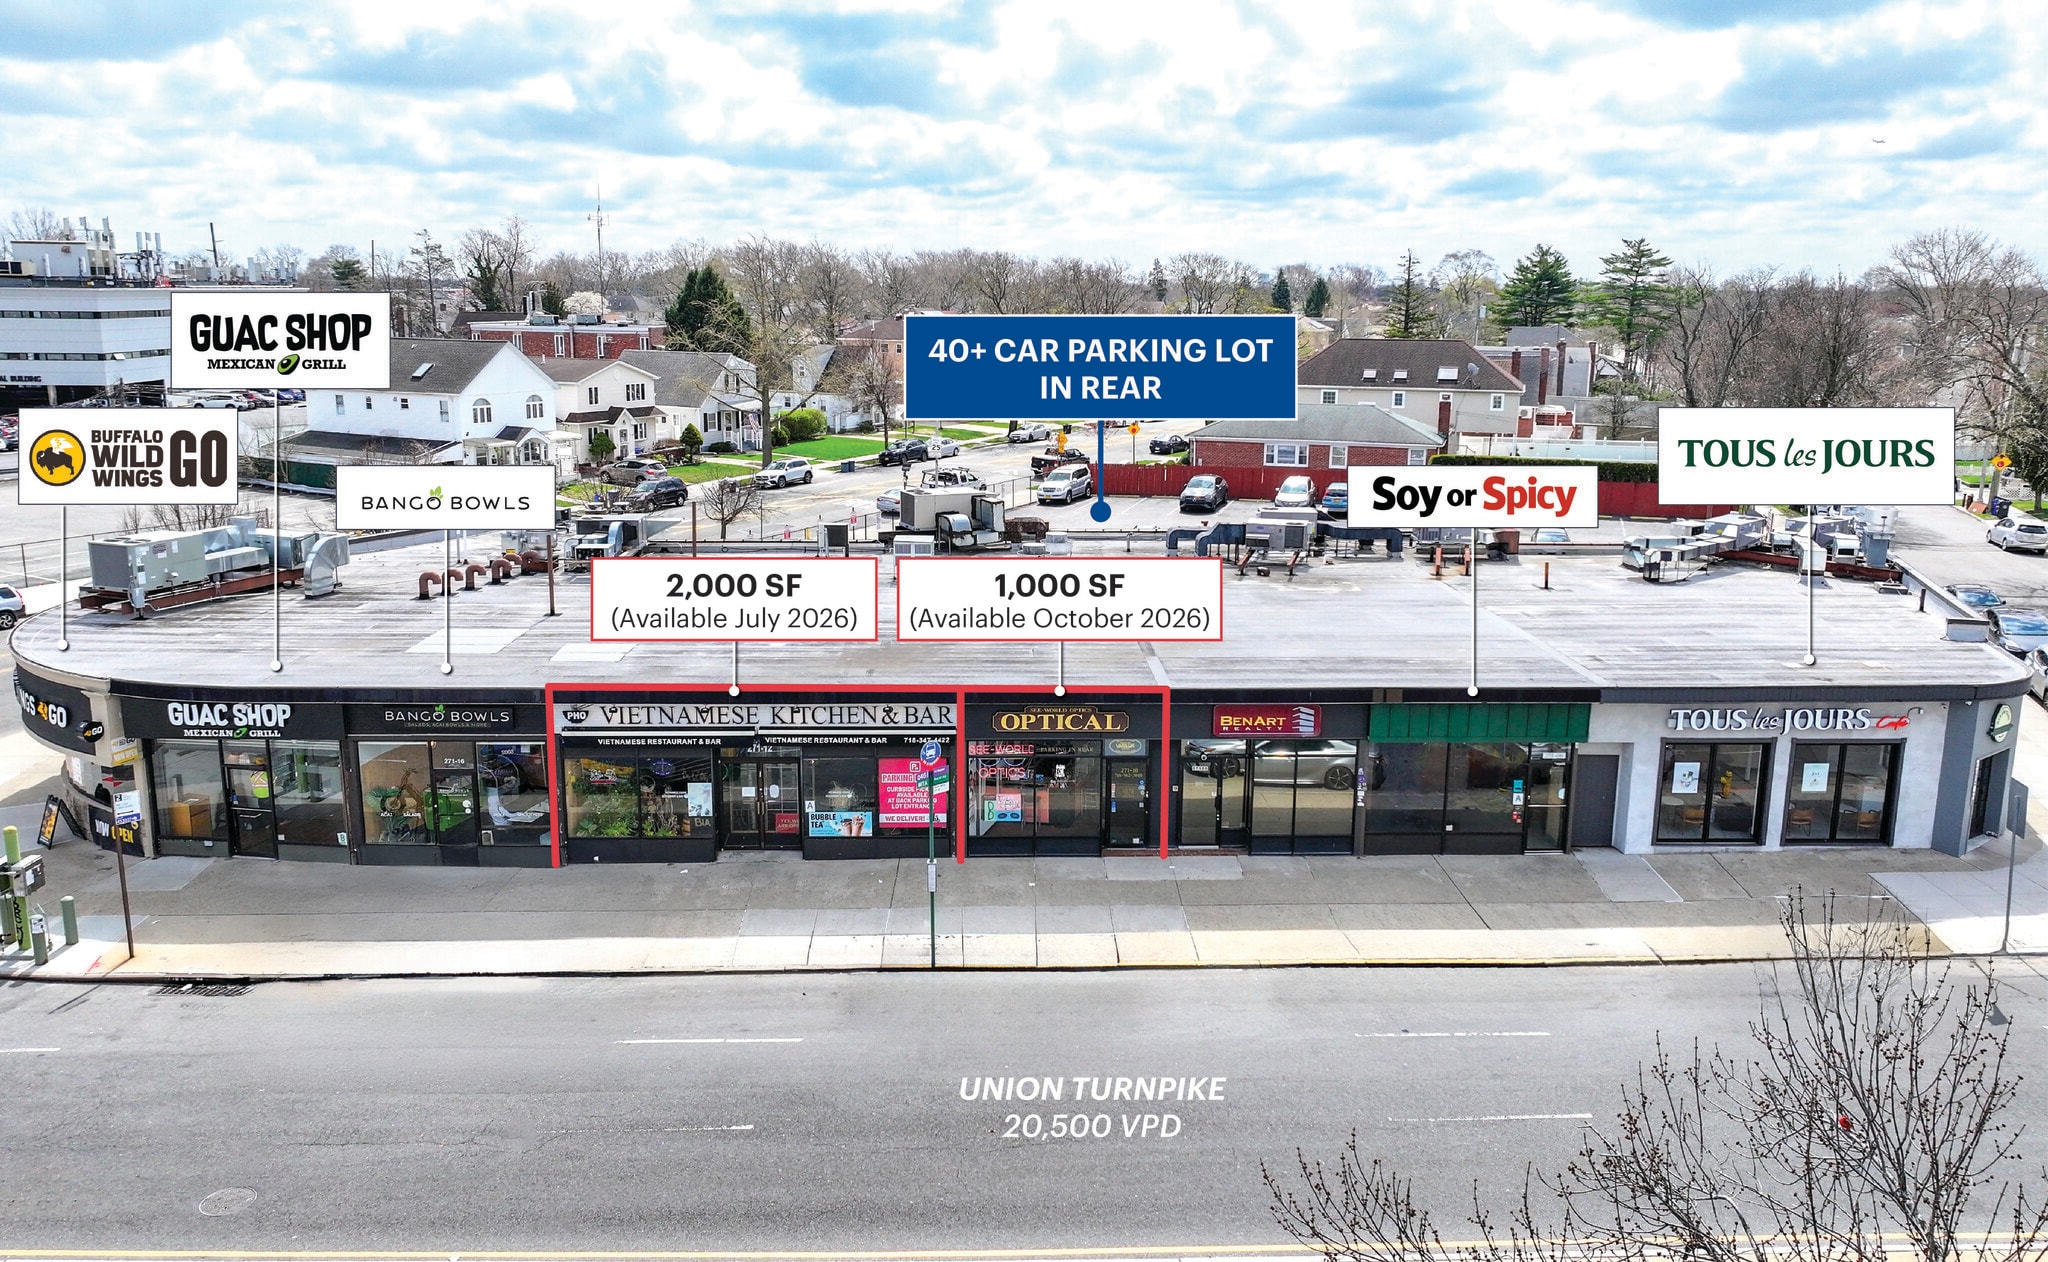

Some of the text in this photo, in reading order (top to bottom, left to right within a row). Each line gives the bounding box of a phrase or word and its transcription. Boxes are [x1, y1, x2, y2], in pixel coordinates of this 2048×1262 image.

[48, 704, 67, 728] GO
[168, 702, 291, 727] GUAC SHOP
[385, 711, 510, 722] BANGO BOWLS
[567, 711, 586, 720] PHO
[600, 706, 954, 725] VIETNAMESE KITCHEN & BAR
[1000, 714, 1121, 731] OPTICAL
[1671, 709, 1747, 731] TOUS
[1752, 707, 1779, 731] les
[1779, 708, 1871, 735] JOURS
[91, 725, 103, 735] GO
[184, 729, 281, 738] MEXICAN GRILL
[882, 774, 913, 782] PARKING
[978, 767, 1026, 778] OPTICS
